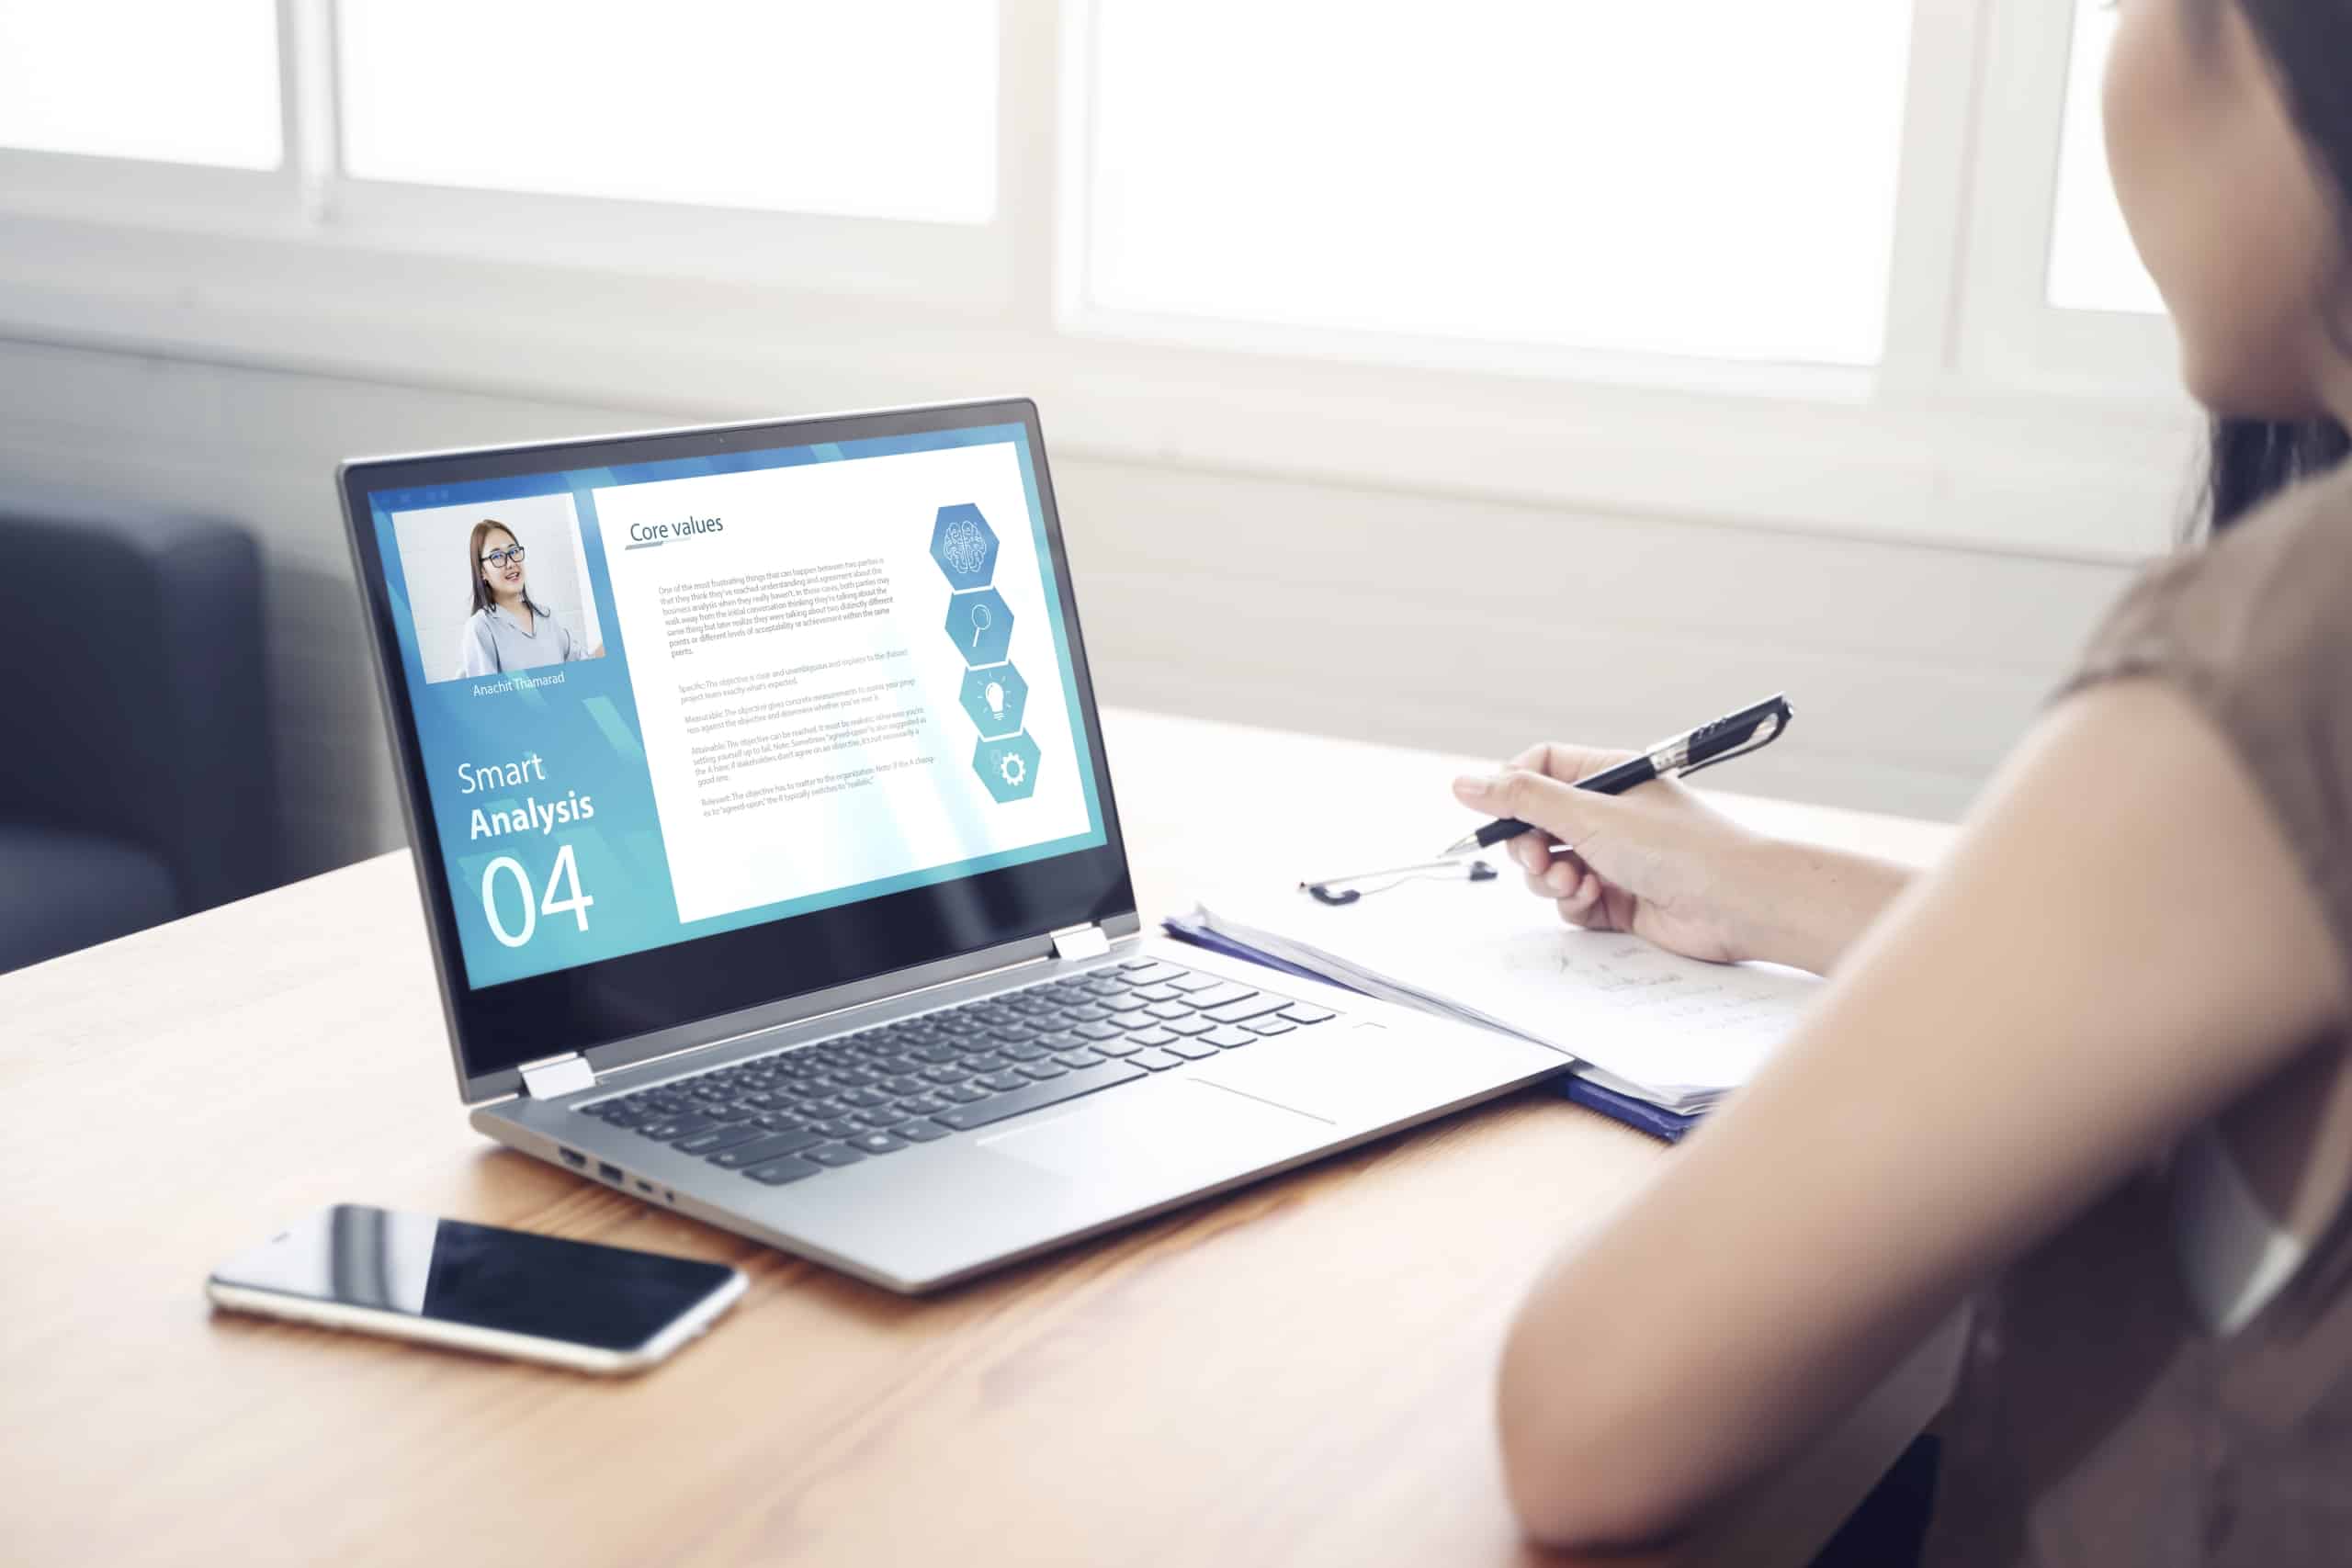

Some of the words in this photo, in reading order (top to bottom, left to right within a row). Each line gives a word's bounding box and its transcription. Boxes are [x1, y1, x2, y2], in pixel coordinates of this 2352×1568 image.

[630, 523, 669, 542] Core
[672, 515, 723, 536] values
[473, 681, 513, 697] Anachit
[514, 671, 565, 691] Thamarad
[458, 753, 546, 794] Smart
[471, 790, 594, 840] Analysis
[482, 844, 594, 947] 04
